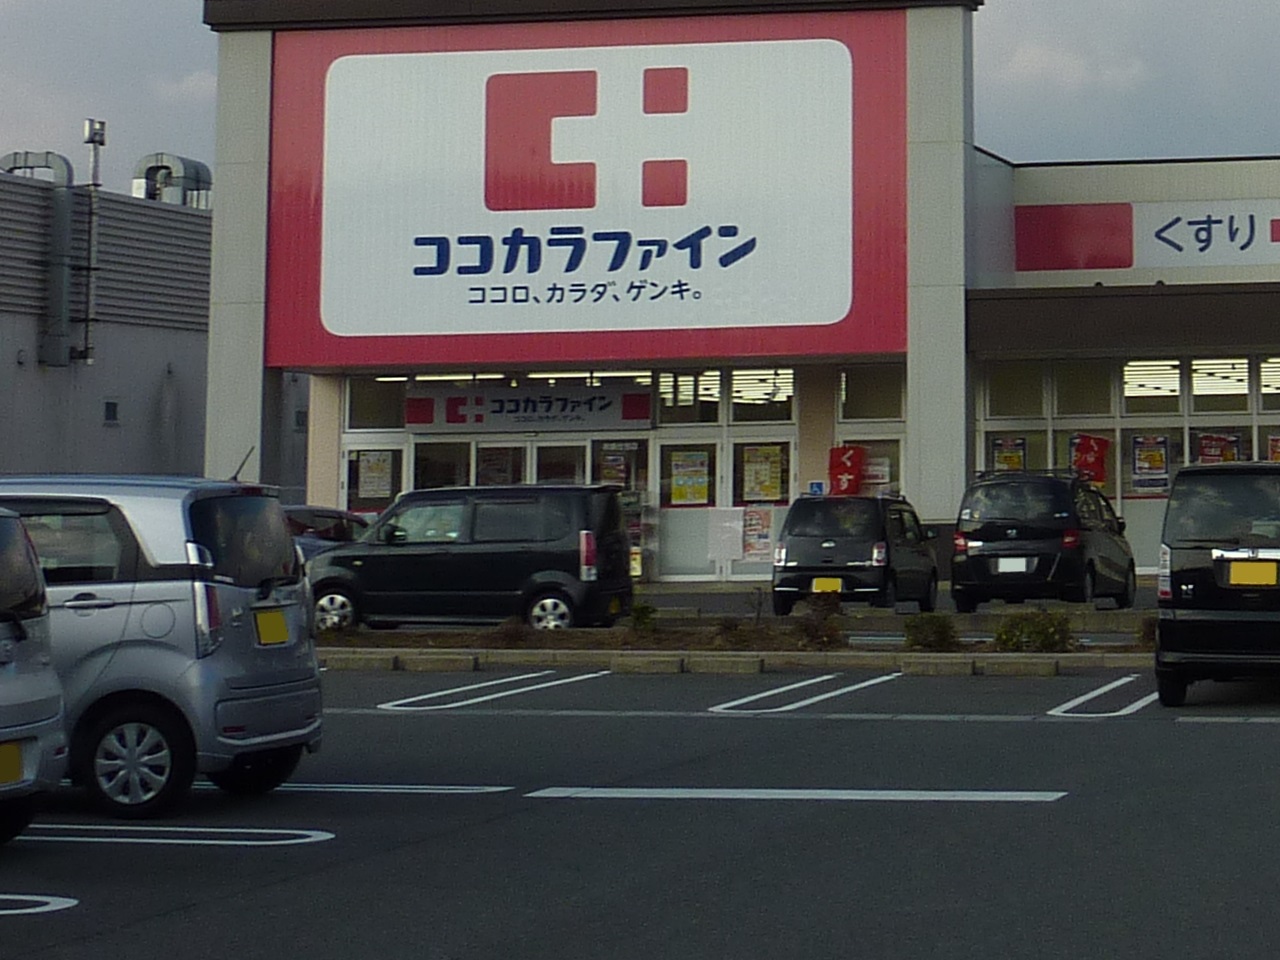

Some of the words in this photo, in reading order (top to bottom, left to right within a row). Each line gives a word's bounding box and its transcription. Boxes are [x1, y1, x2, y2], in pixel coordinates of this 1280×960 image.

[1154, 214, 1256, 253] くすり
[413, 225, 757, 276] ココカラファイン
[468, 280, 702, 304] ココロ、カラダ、ゲンキ。
[490, 395, 613, 414] ココカラファイン
